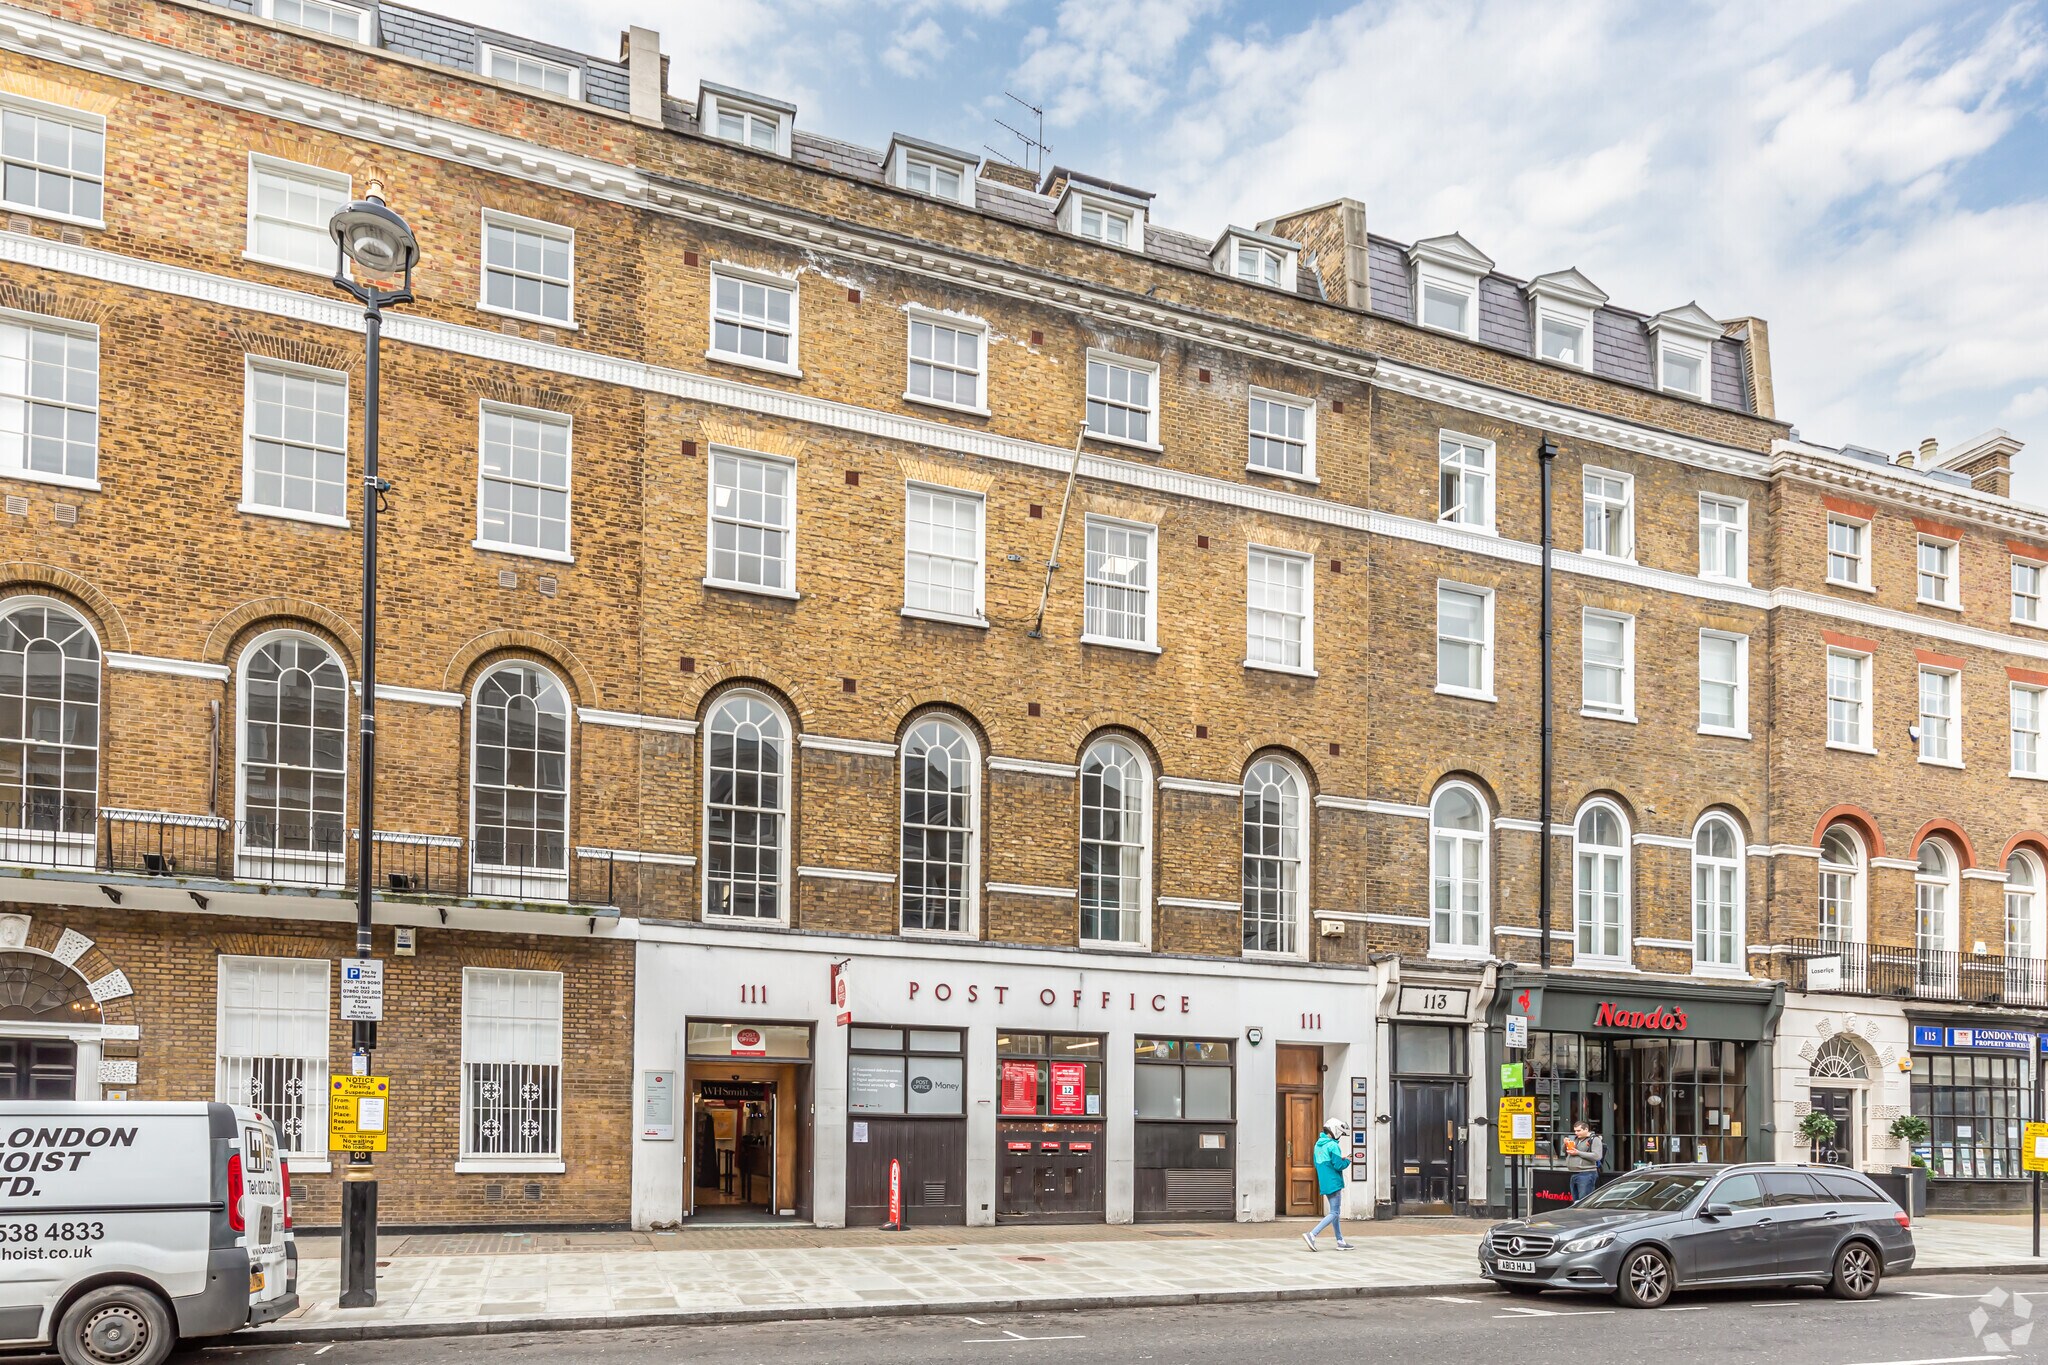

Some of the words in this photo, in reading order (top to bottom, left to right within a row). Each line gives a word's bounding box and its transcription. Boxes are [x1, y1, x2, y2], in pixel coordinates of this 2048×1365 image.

[741, 984, 767, 1003] 111
[909, 981, 1009, 1005] POST
[1040, 988, 1190, 1013] OFFICE
[1424, 994, 1447, 1009] 113
[1301, 1013, 1321, 1029] 111
[1594, 1001, 1688, 1030] Nando's
[1924, 1032, 1936, 1040] 115
[935, 1082, 959, 1091] Money
[1542, 1190, 1573, 1201] Nando's
[44, 1222, 105, 1241] 4833
[2, 1246, 93, 1260] hoist.co.uk
